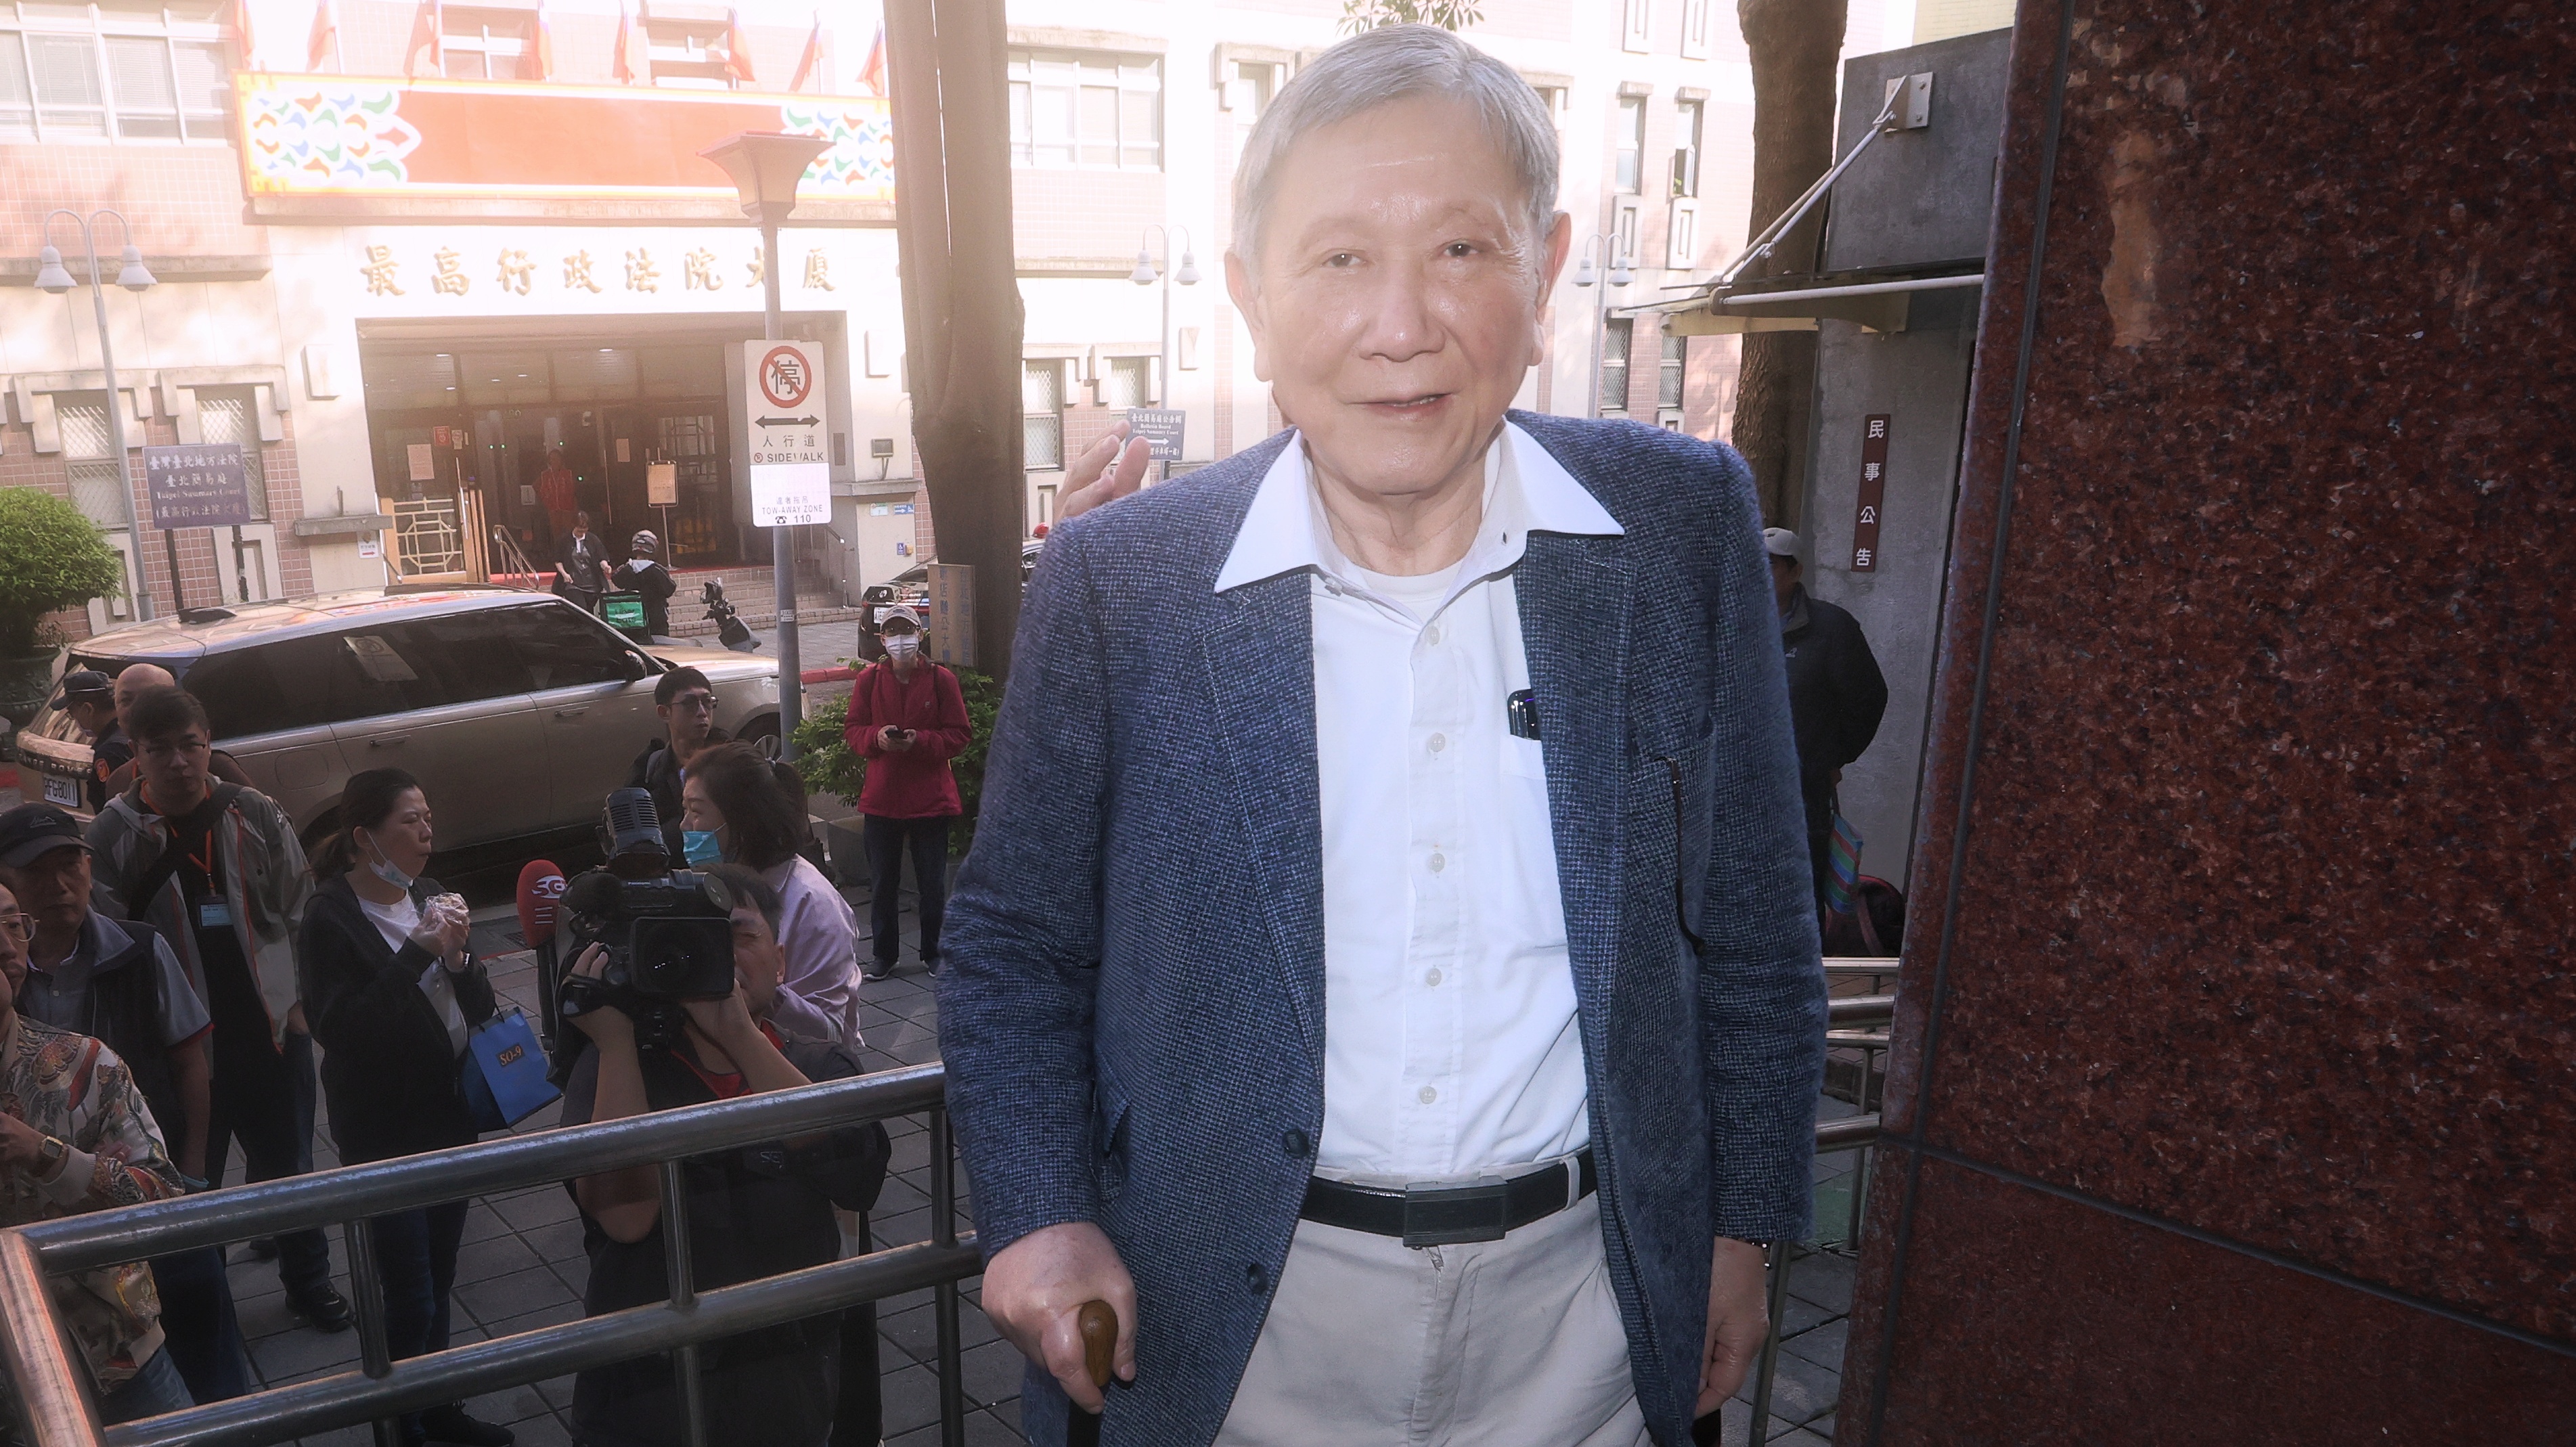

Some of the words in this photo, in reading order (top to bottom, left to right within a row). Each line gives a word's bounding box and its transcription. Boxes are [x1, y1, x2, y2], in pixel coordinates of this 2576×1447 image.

[359, 245, 836, 296] 最高行政法院大廈
[763, 435, 815, 448] 人行道
[1856, 420, 1884, 566] 民事公告
[776, 495, 808, 505] 違者拖吊
[761, 506, 801, 515] TOW-AWAY
[803, 504, 823, 513] ZONE
[794, 514, 812, 524] 110
